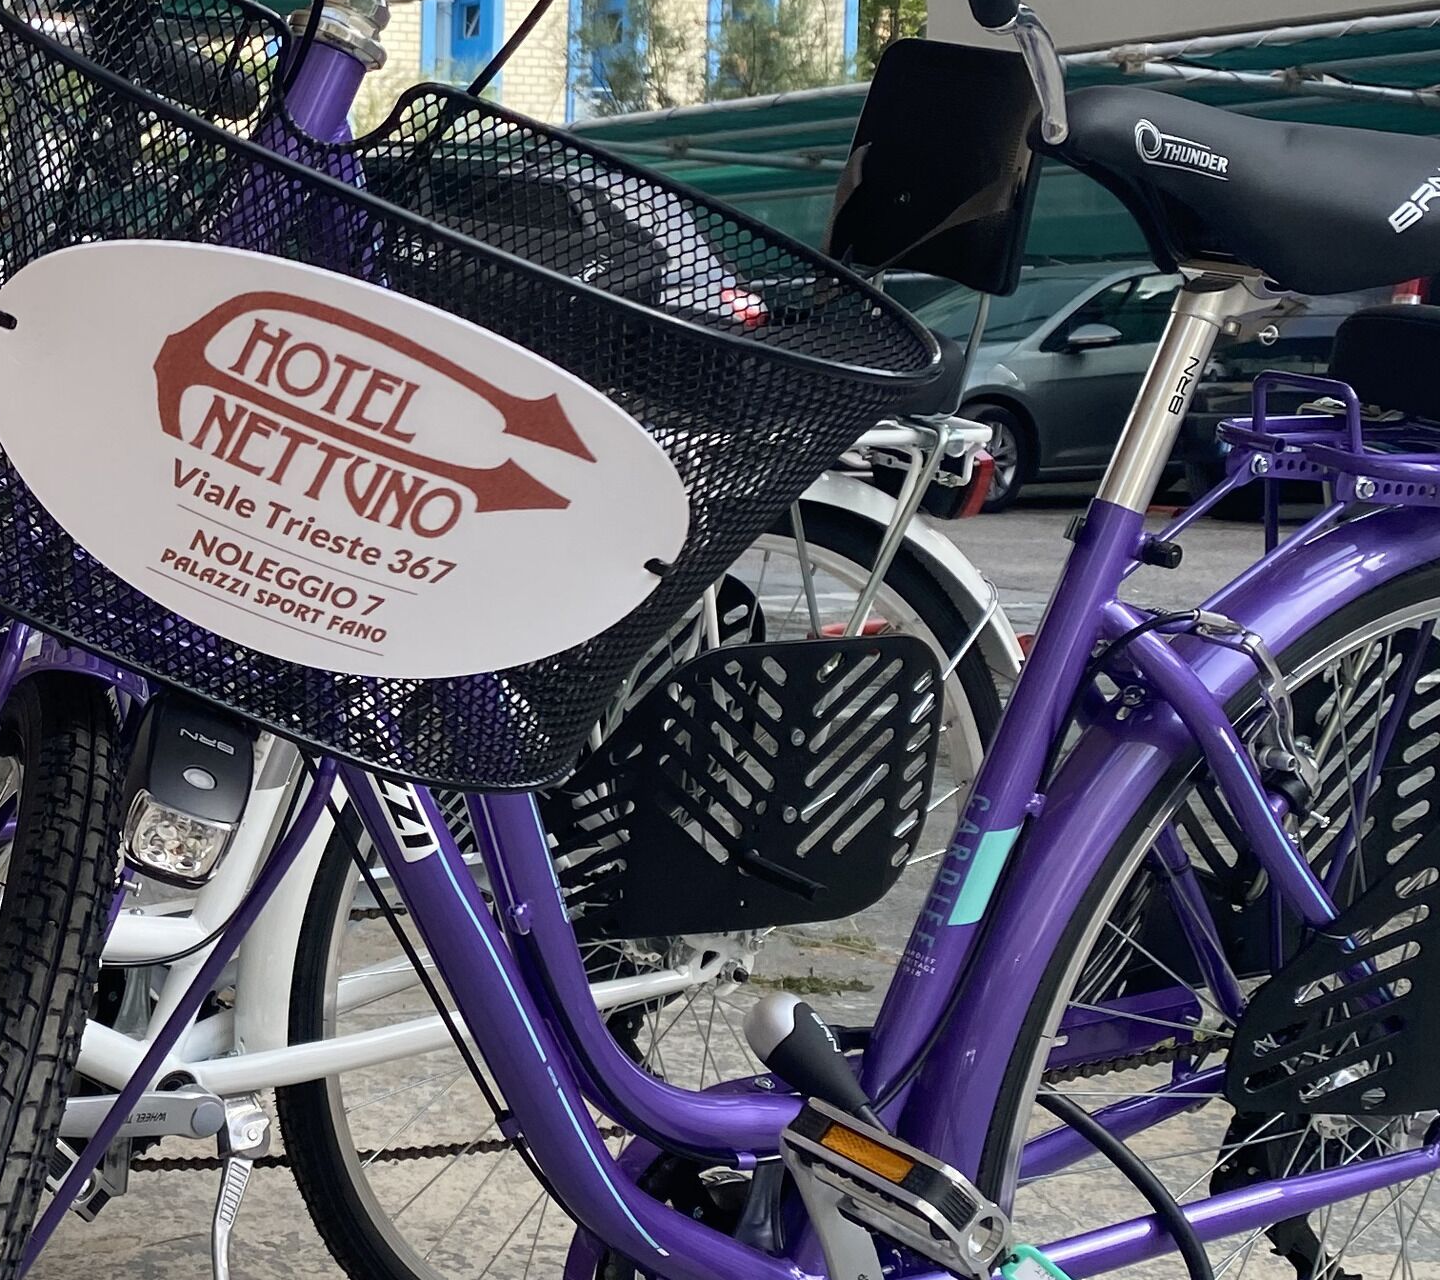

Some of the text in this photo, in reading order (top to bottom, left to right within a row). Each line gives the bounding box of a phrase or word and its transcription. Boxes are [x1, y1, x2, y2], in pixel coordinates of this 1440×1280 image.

[1163, 142, 1229, 173] THUNDER
[227, 318, 421, 444] HOTEL
[1168, 356, 1200, 415] BRN
[189, 394, 462, 539] NETTUNO
[174, 457, 457, 584] Viale Trieste 367
[160, 548, 387, 643] PALAZZI SPORT FANO
[189, 529, 385, 616] NOLEGGIO 7
[179, 728, 235, 756] BRN
[917, 793, 991, 949] CARDIFF
